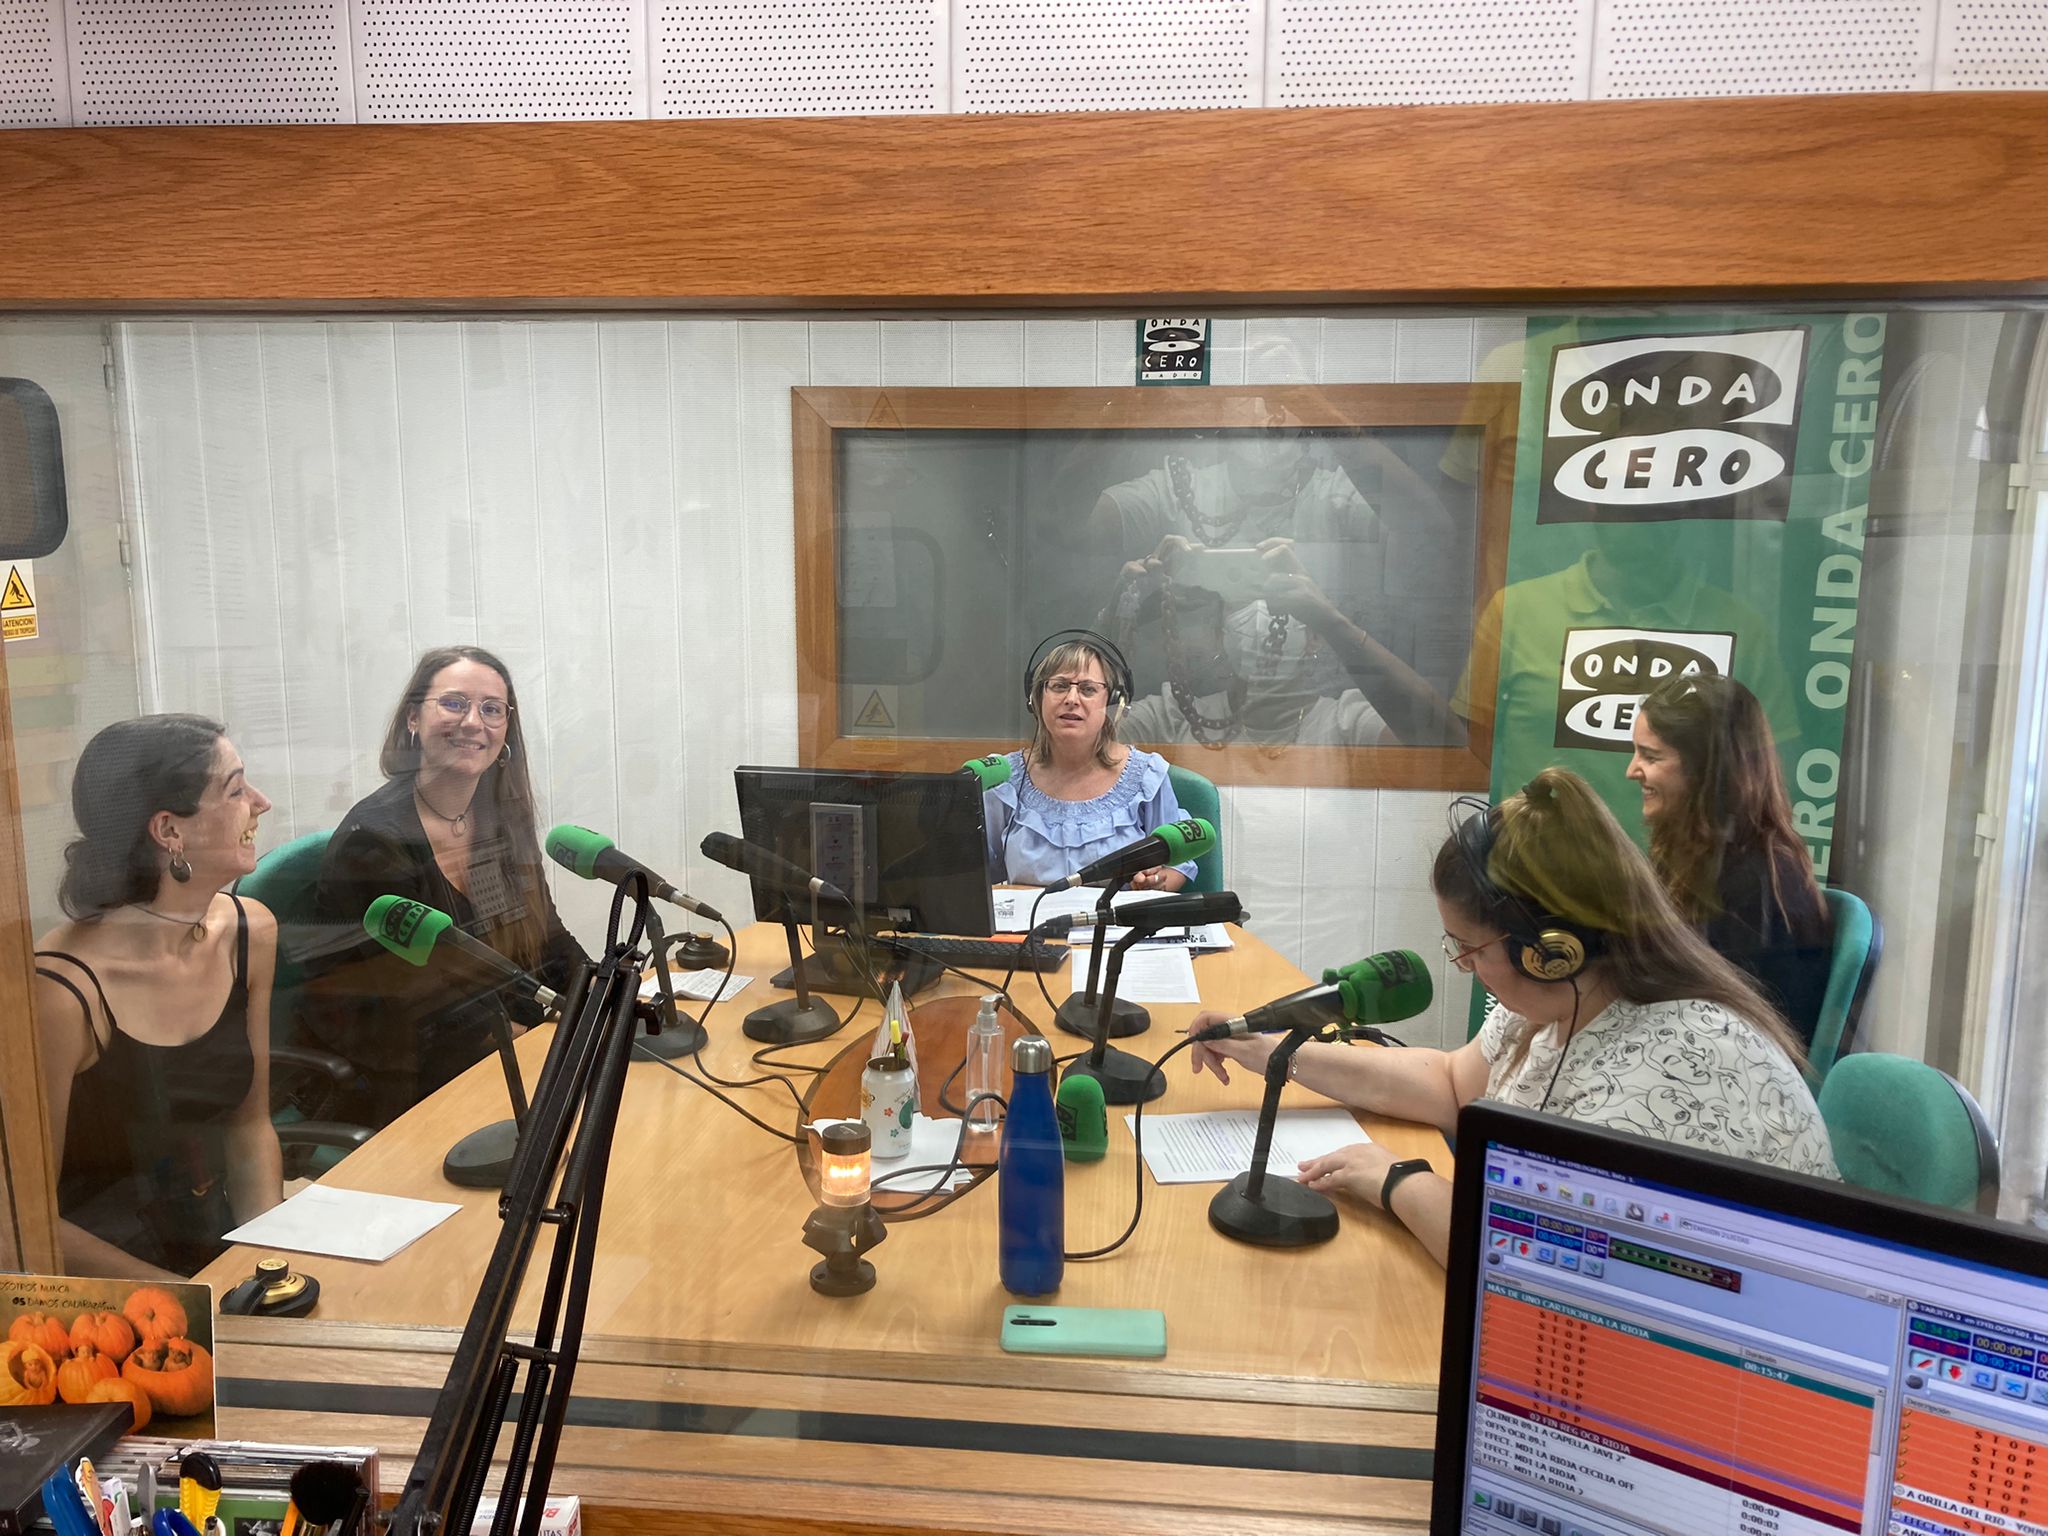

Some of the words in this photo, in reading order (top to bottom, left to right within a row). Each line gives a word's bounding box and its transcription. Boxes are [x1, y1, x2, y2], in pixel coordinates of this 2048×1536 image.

[1151, 319, 1200, 328] ONDA
[1145, 355, 1197, 368] CERO
[1581, 372, 1756, 415] ONDA
[1829, 313, 1887, 479] CERO
[1584, 446, 1751, 489] CERO
[1805, 503, 1869, 710] ONDA
[1585, 701, 1635, 730] CE
[1793, 748, 1840, 889] ERO
[12, 1296, 26, 1306] OS
[28, 1297, 59, 1308] DAMOS
[1620, 1321, 1649, 1339] RIOJA
[1744, 1361, 1789, 1381] 00:15:47
[1550, 1432, 1590, 1451] CAPELLA
[1602, 1437, 1630, 1454] RIOJA
[1550, 1467, 1576, 1481] RIOJA
[1551, 1455, 1577, 1470] RIOJA
[1579, 1465, 1615, 1485] CECILIA
[1618, 1480, 1634, 1491] OFF
[1742, 1499, 1779, 1518] 0:00:02
[1907, 1490, 1915, 1499] A
[1918, 1494, 1958, 1512] ORILLA
[1961, 1507, 1980, 1519] DEL
[1984, 1514, 2005, 1526] RIO
[1741, 1511, 1779, 1531] 0:00:03
